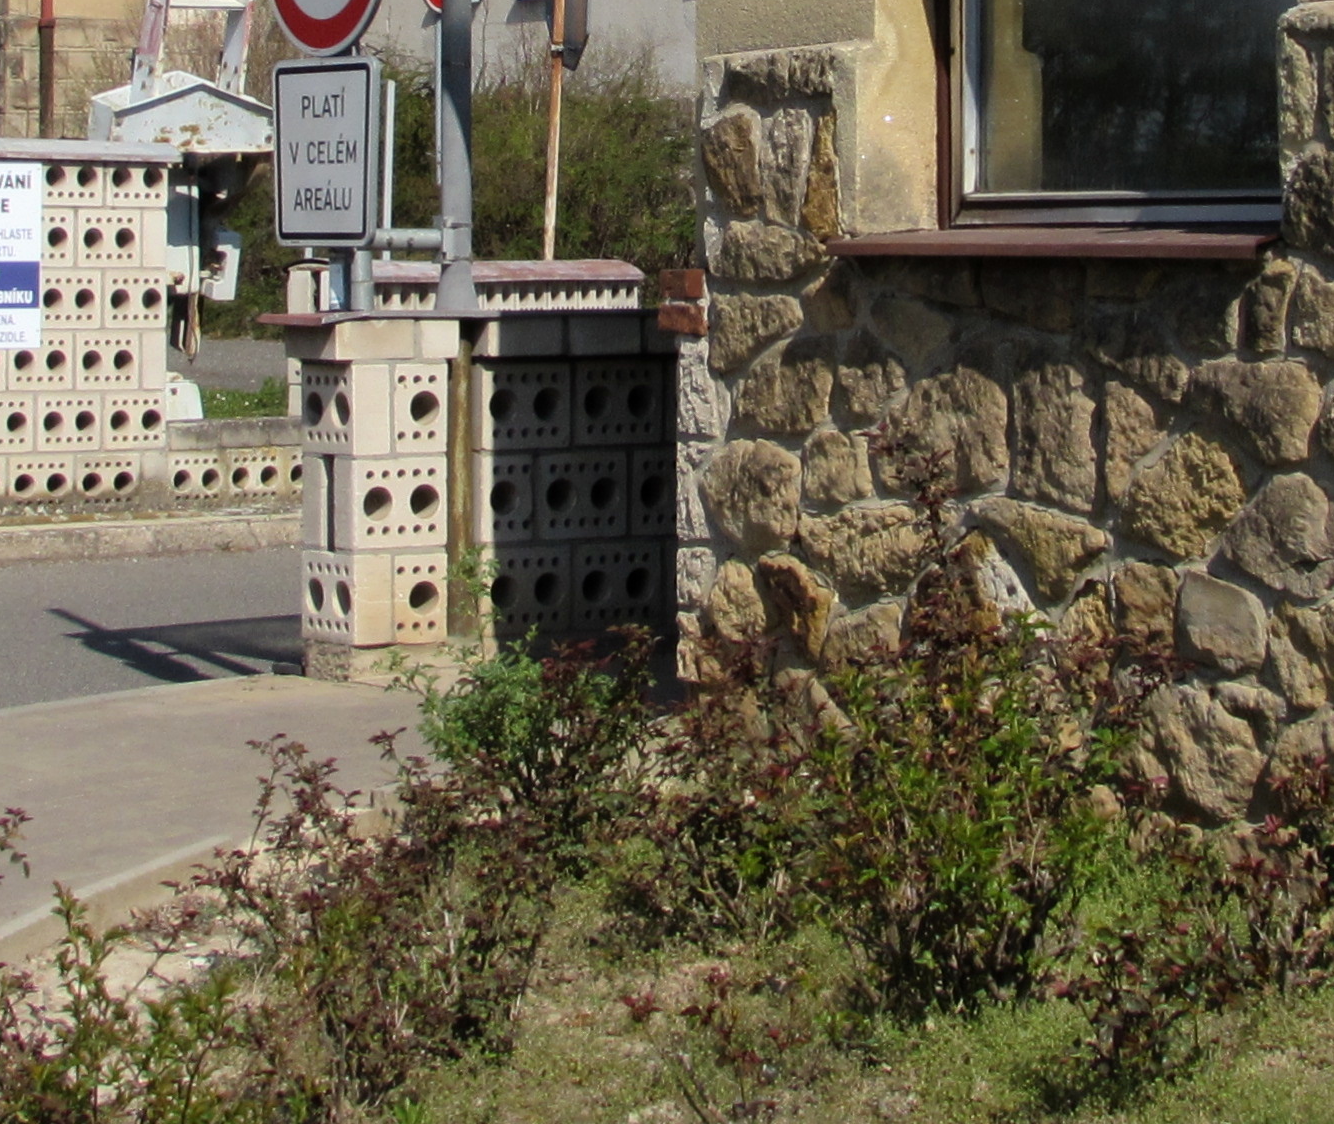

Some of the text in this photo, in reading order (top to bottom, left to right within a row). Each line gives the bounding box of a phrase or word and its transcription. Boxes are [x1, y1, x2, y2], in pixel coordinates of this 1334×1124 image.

[301, 86, 345, 118] PLATÍ
[289, 133, 357, 165] V CELÉM
[293, 179, 353, 211] AREÁLU
